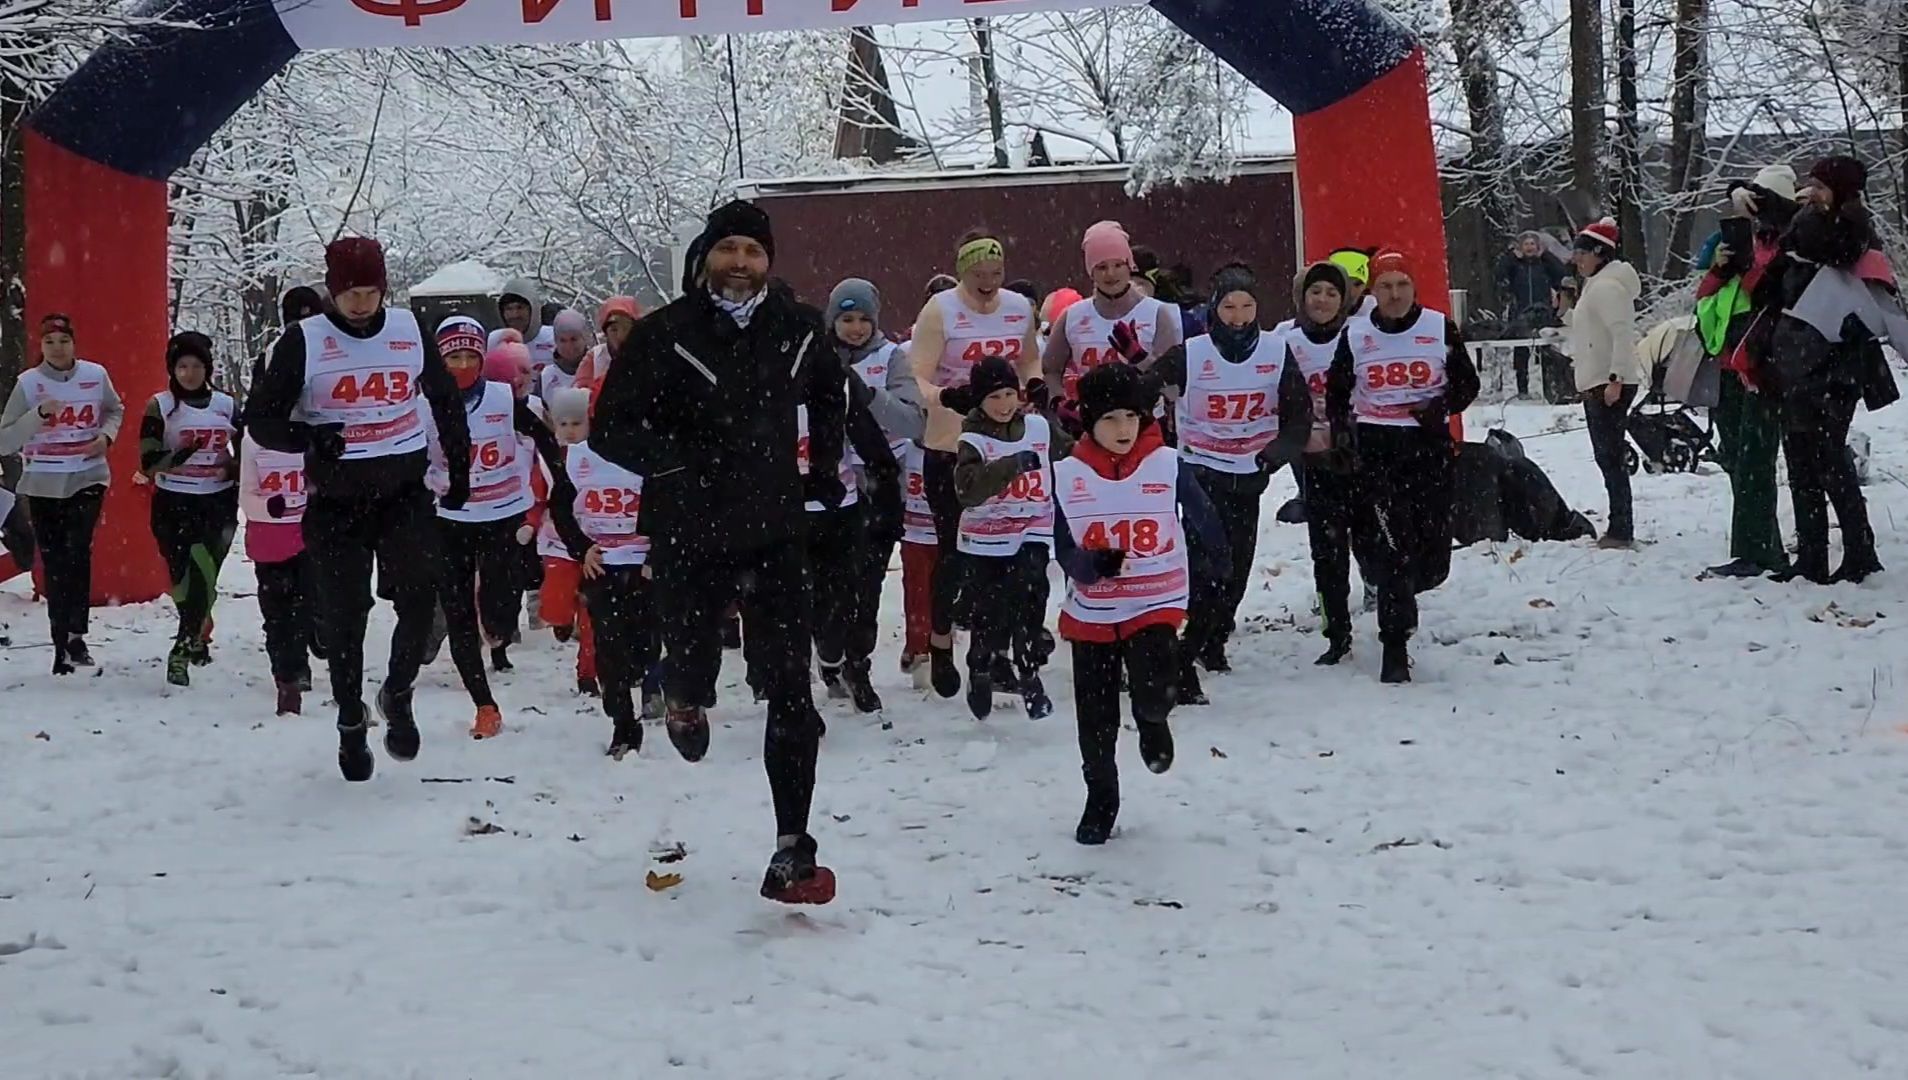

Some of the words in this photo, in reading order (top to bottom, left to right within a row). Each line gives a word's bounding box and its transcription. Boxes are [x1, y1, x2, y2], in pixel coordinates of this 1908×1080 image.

[331, 371, 409, 403] 443
[1367, 361, 1431, 388] 389
[1207, 392, 1267, 420] 372
[585, 488, 641, 513] 432
[1082, 519, 1158, 552] 418
